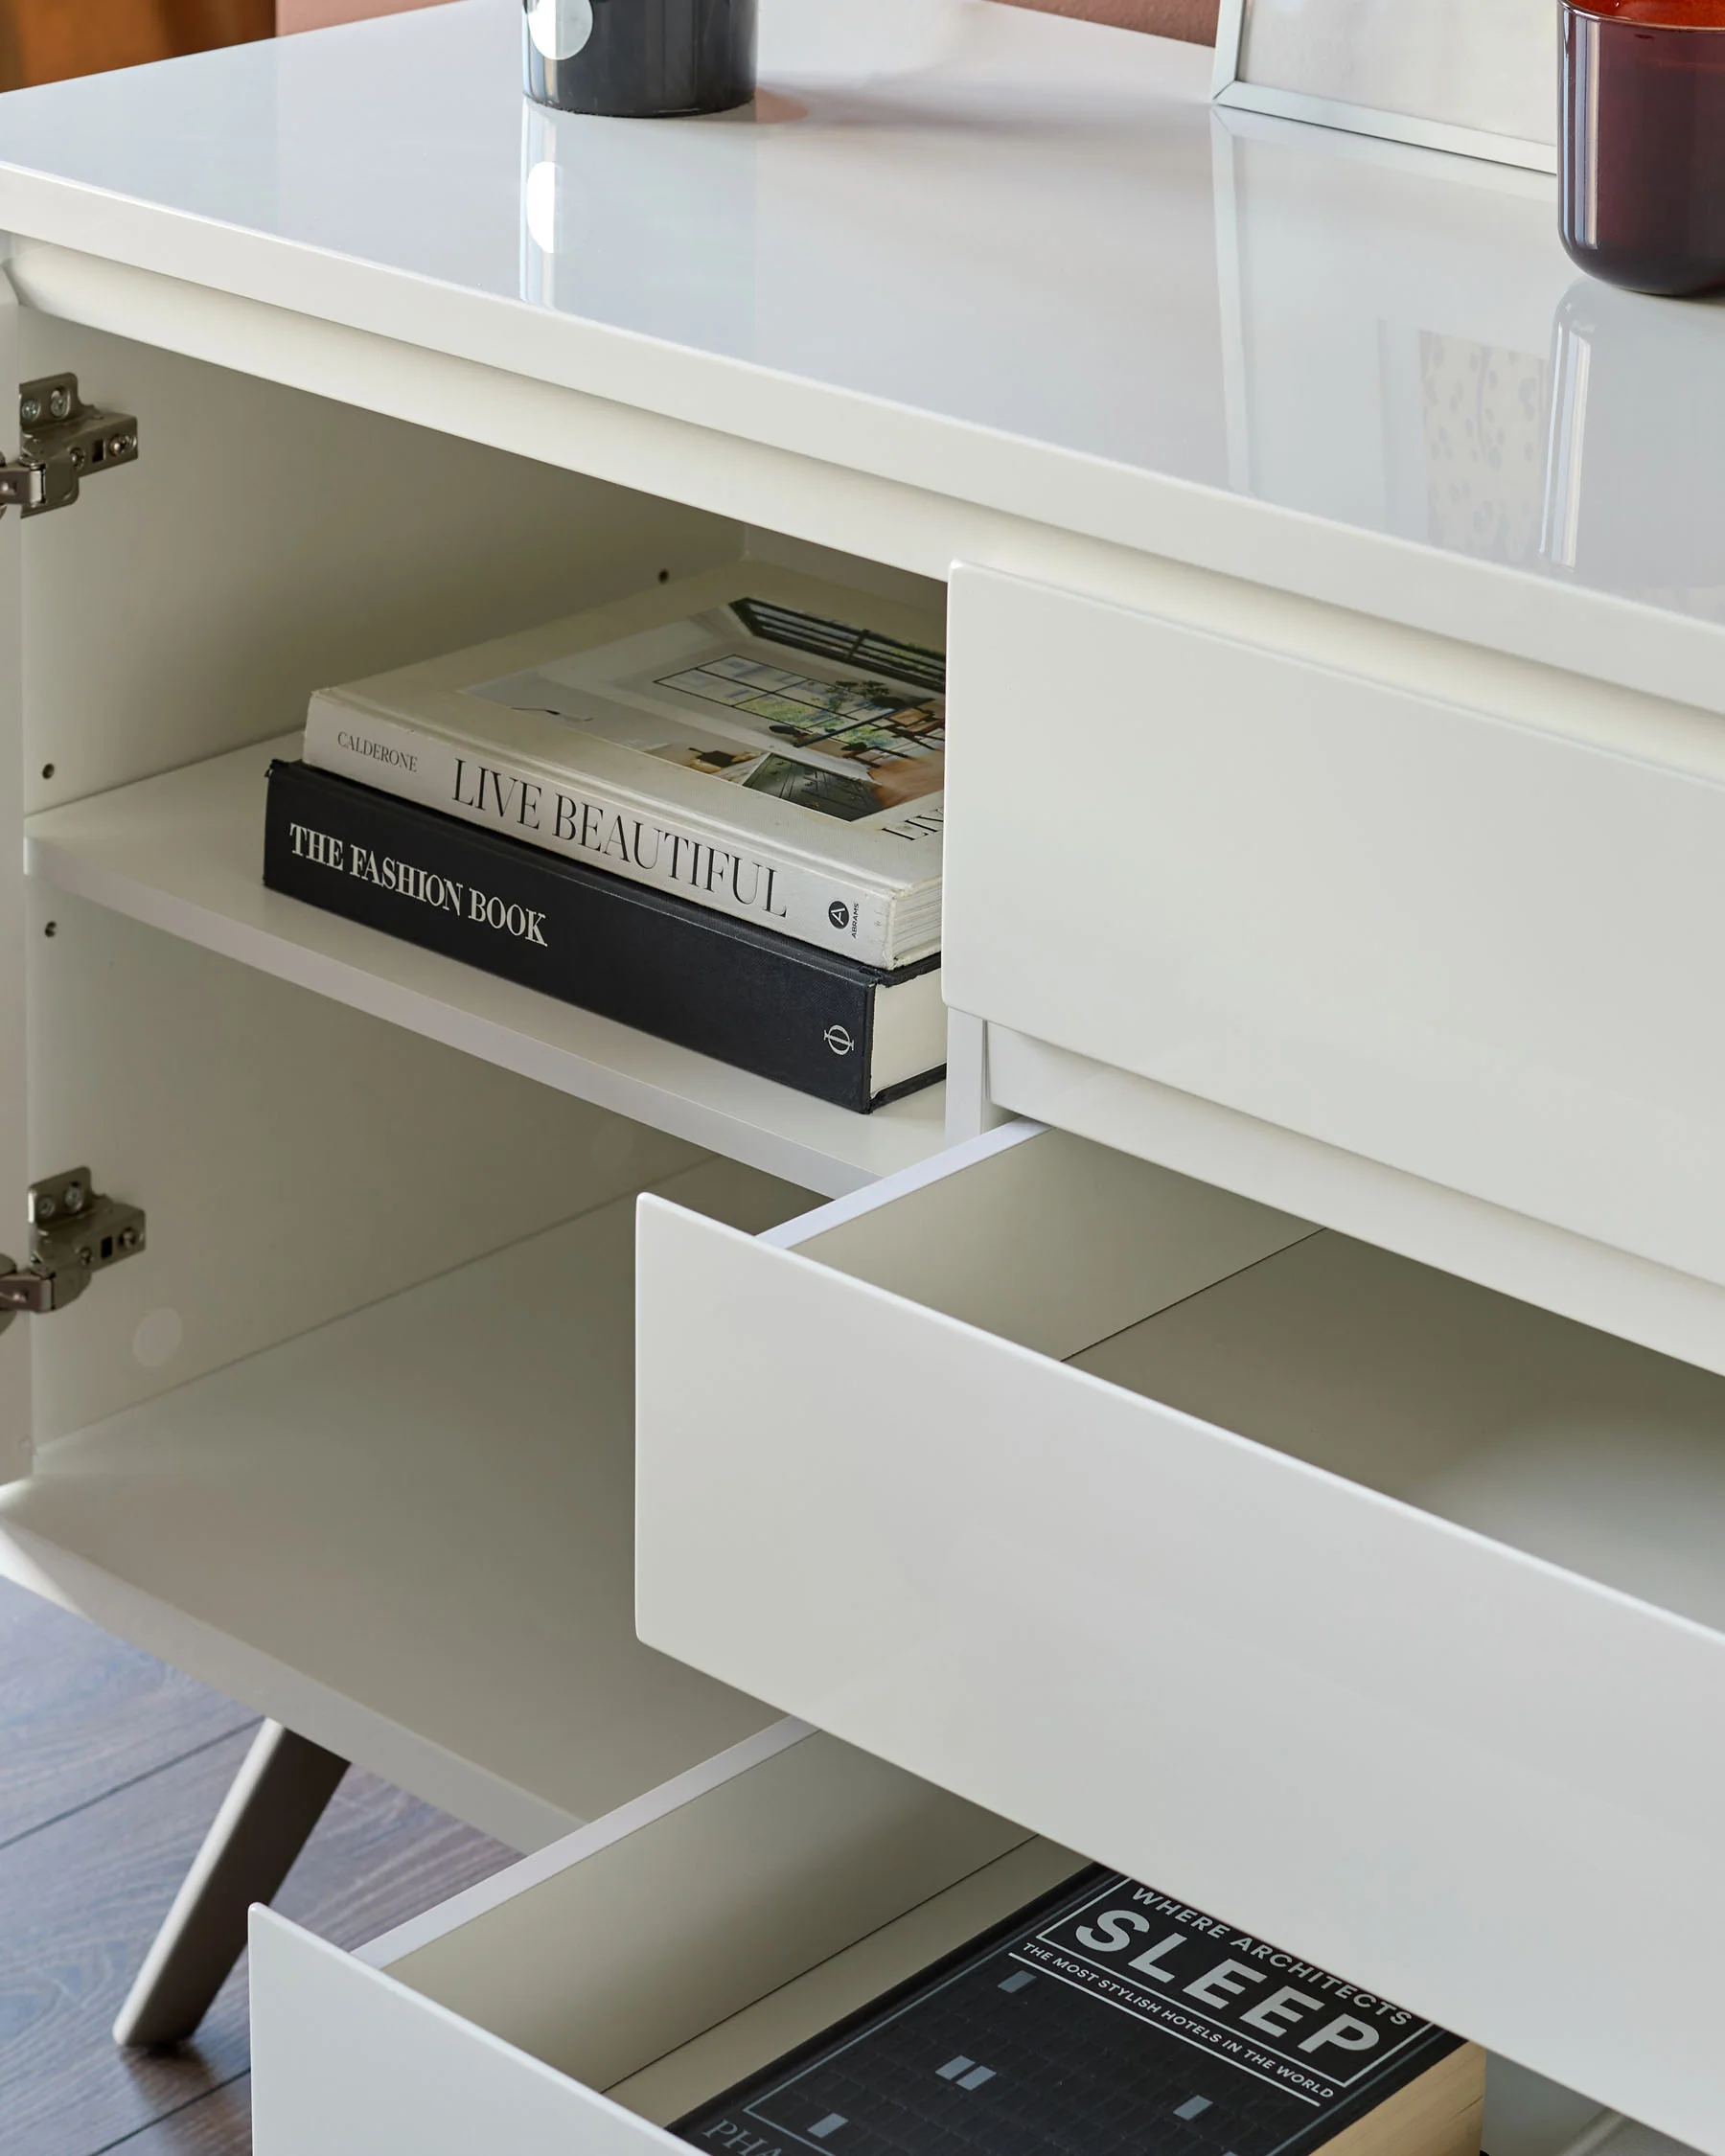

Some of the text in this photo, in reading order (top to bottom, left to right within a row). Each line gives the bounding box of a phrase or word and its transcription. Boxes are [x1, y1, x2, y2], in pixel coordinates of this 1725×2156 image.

[336, 730, 418, 773] CALDERONE
[289, 822, 548, 948] THE FASHION BOOK
[451, 757, 788, 918] LIVE BEAUTIFUL
[851, 903, 860, 939] ABRAMS
[1023, 1942, 1334, 2099] THE MOST STYLISH HOTELS IN THE WORLD
[1075, 1910, 1380, 2053] SLEEP
[1132, 1887, 1414, 2027] WHERE ARCHITECTS
